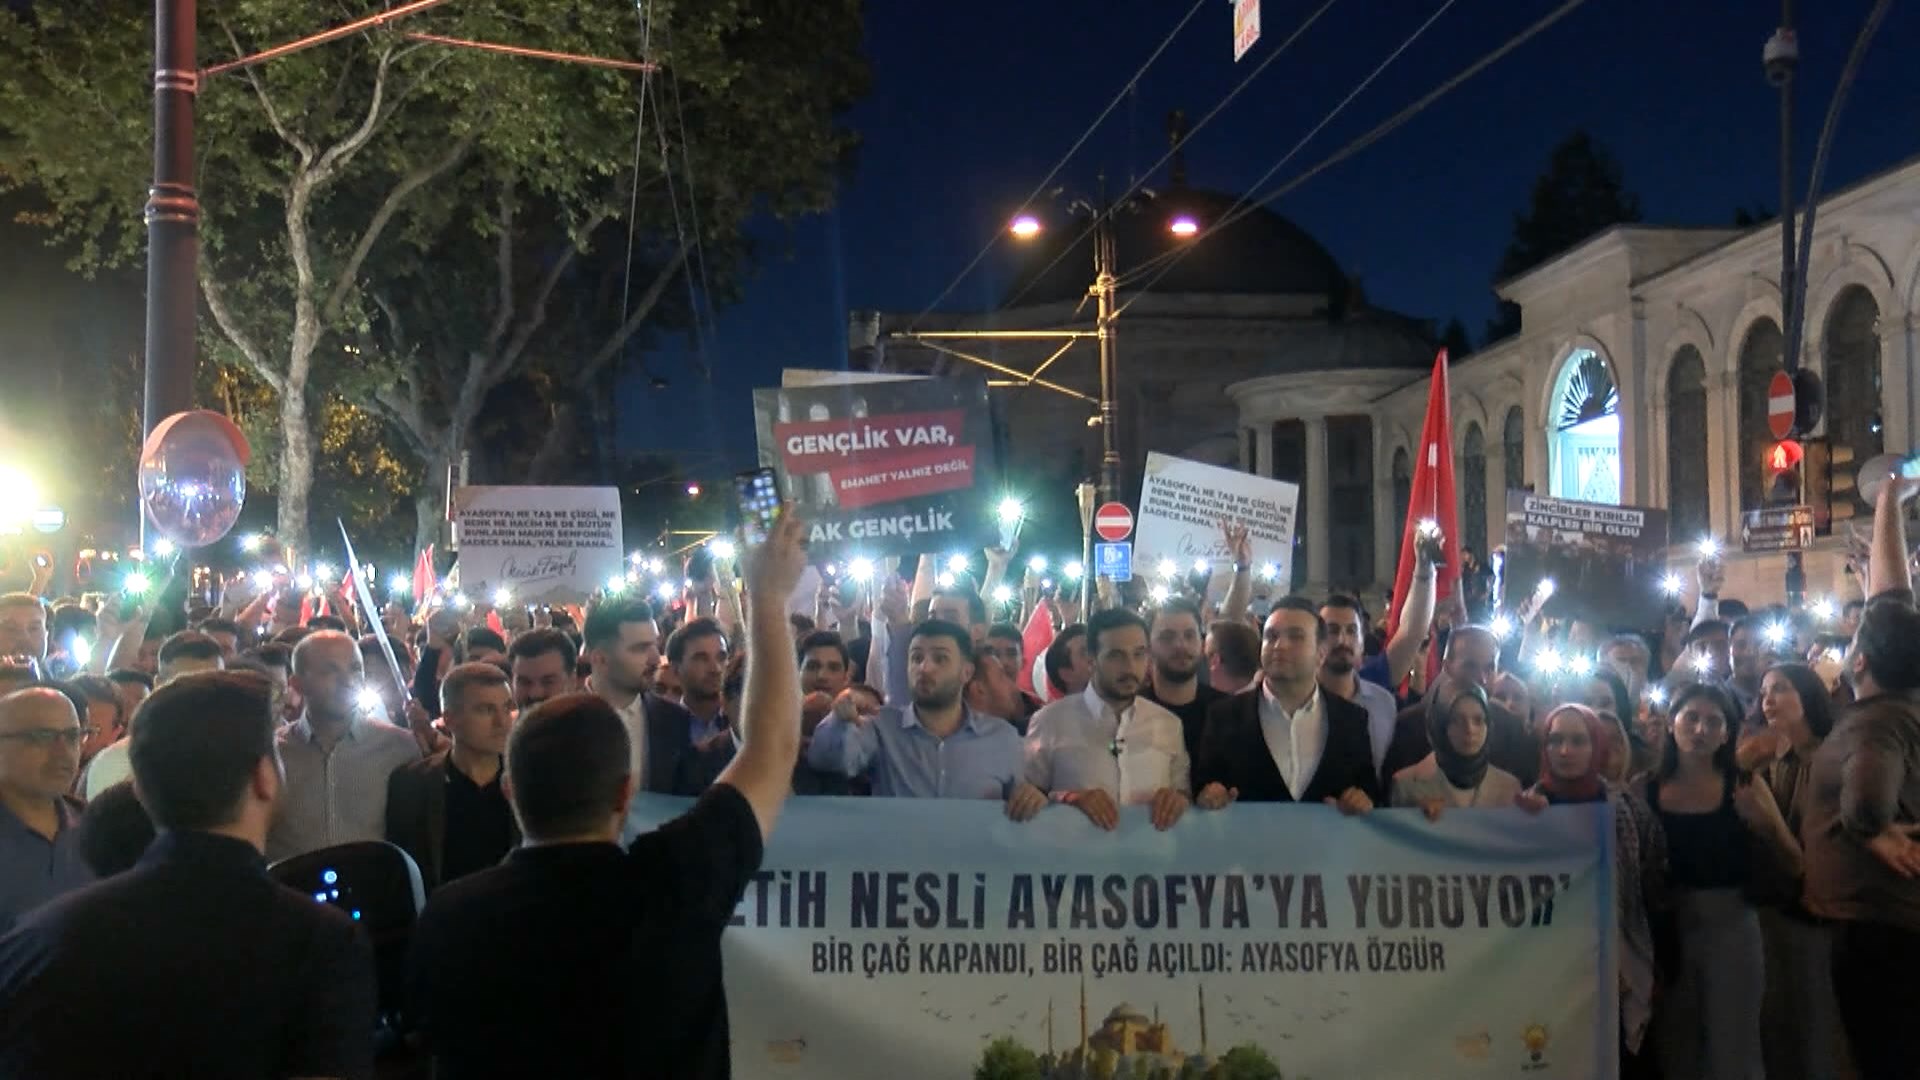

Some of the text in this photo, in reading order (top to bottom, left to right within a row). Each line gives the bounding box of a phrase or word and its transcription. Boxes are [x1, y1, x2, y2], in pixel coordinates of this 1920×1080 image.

[787, 426, 954, 456] GENÇLİK VAR,
[840, 460, 969, 490] EMANET YALNIZ DEĞİL
[1143, 506, 1180, 520] SADECE
[1149, 497, 1197, 514] BUNLARIN
[1200, 509, 1233, 522] MADDE
[1151, 488, 1287, 523] RENK NE HACİM NE DE BÜTÜN
[1202, 489, 1214, 497] NE
[1217, 492, 1234, 502] TAŞ
[1280, 506, 1292, 514] NE
[1529, 501, 1640, 523] ZİNCİRLER KIRILDI
[510, 519, 542, 527] HACİM
[578, 519, 612, 528] BÜTÜN
[809, 508, 953, 542] AK GENÇLİK
[1528, 515, 1640, 537] KALPLER BİR OLDU
[538, 539, 572, 547] YALNIZ
[851, 872, 985, 929] NESLİ
[1007, 873, 1328, 930] AYASOFYA'YA
[812, 936, 1445, 979] BİR ÇAĞ KAPANDI, BİR ÇAĞ AÇILDI: AYASOFYA ÖZGÜR
